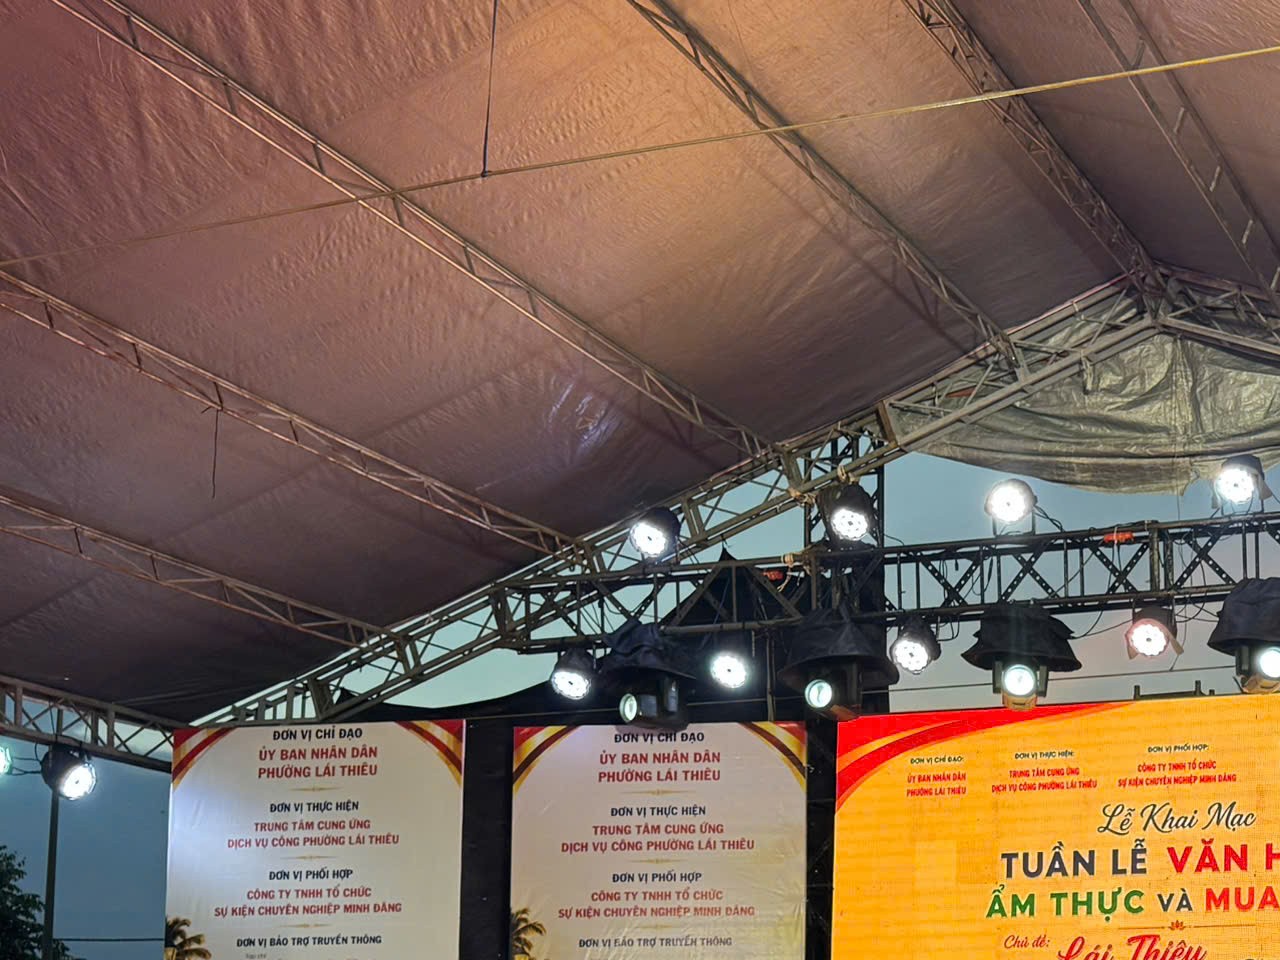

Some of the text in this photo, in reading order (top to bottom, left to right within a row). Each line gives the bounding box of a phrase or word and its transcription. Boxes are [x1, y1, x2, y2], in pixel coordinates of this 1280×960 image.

[259, 744, 377, 761] ỦY BAN NHÂN DÂN
[600, 747, 720, 764] ỦY BAN NHÂN DÂN
[258, 761, 377, 779] PHƯỜNG LÁI THIÊU
[599, 766, 720, 782] PHƯỜNG LÁI THIÊU
[1097, 802, 1256, 836] Lễ Khai Mạc
[1001, 842, 1095, 878] TUẦN
[1112, 838, 1146, 875] LỄ
[1167, 838, 1248, 873] VĂN
[987, 884, 1035, 918] ẨM
[1051, 888, 1144, 922] THỰC
[1158, 891, 1192, 912] VÀ
[1206, 886, 1279, 912] MUA
